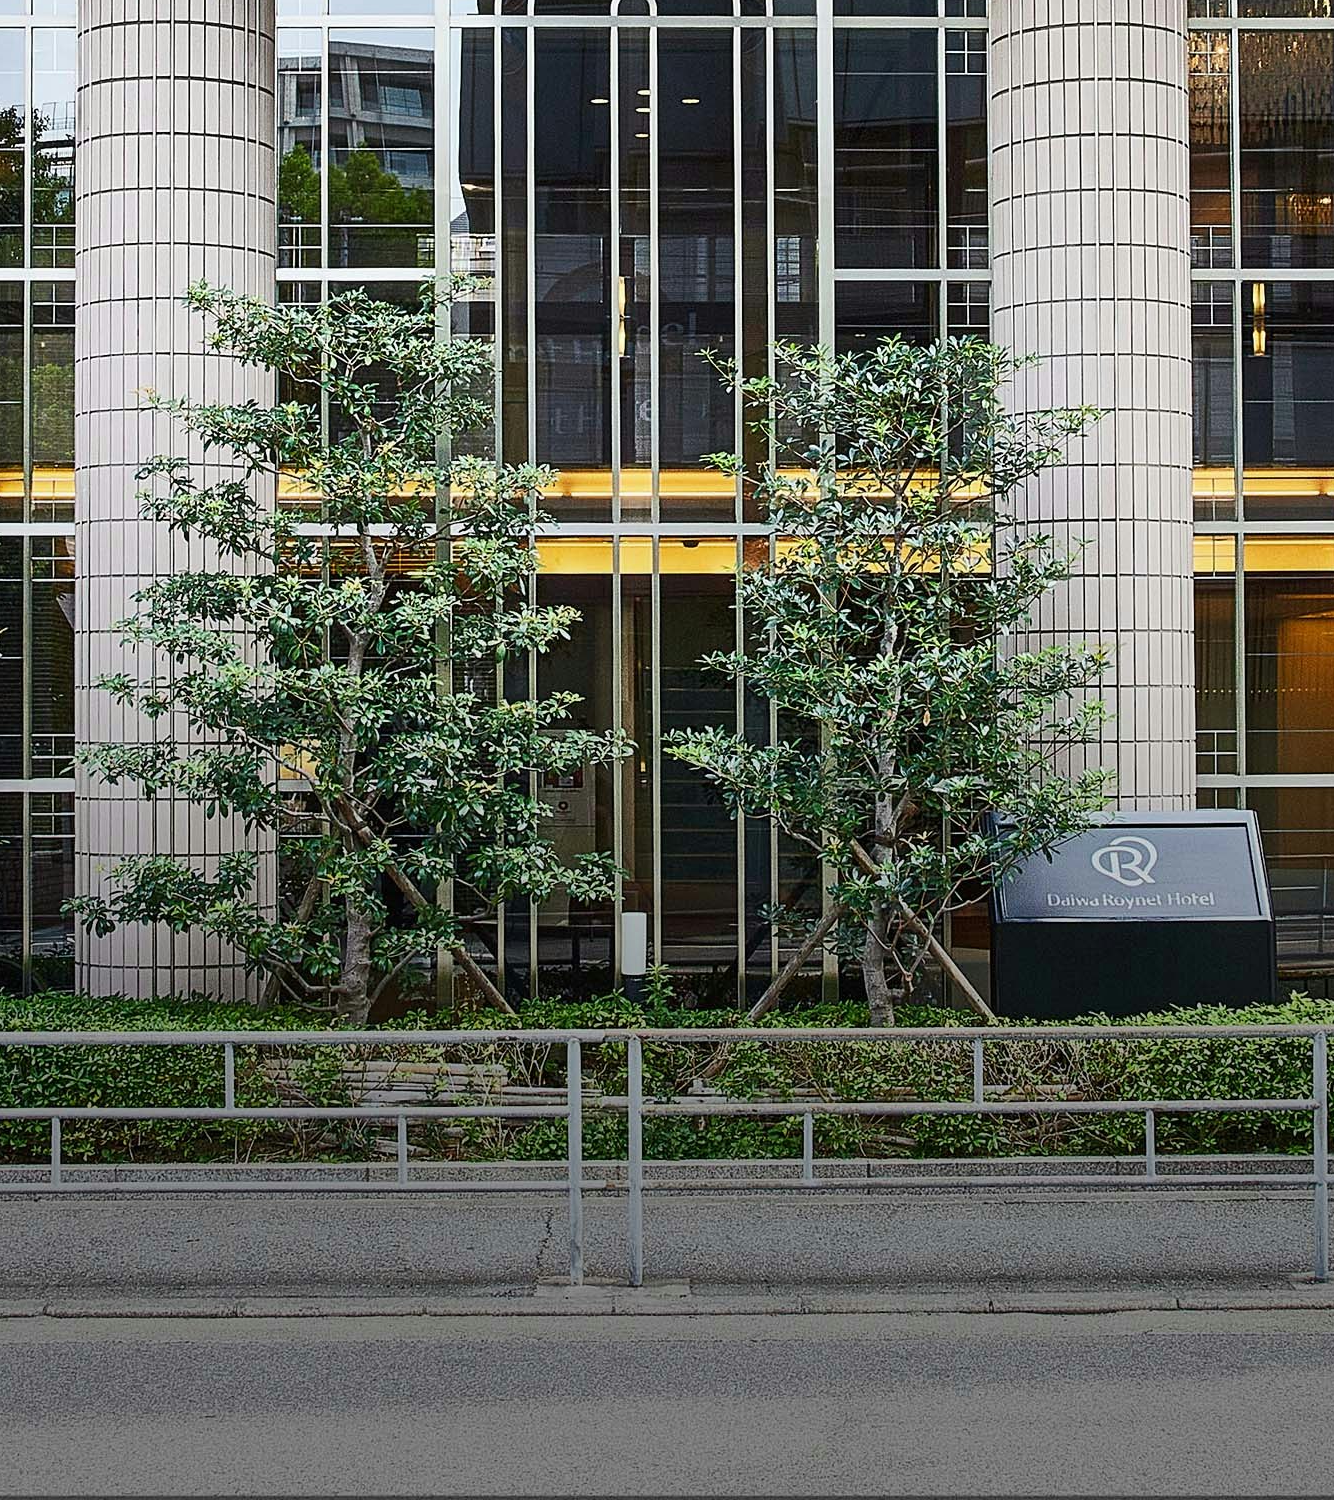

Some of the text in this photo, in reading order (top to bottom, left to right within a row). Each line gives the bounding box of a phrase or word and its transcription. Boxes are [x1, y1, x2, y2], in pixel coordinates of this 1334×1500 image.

[1047, 891, 1215, 910] Daiwa Roynet Hotel
